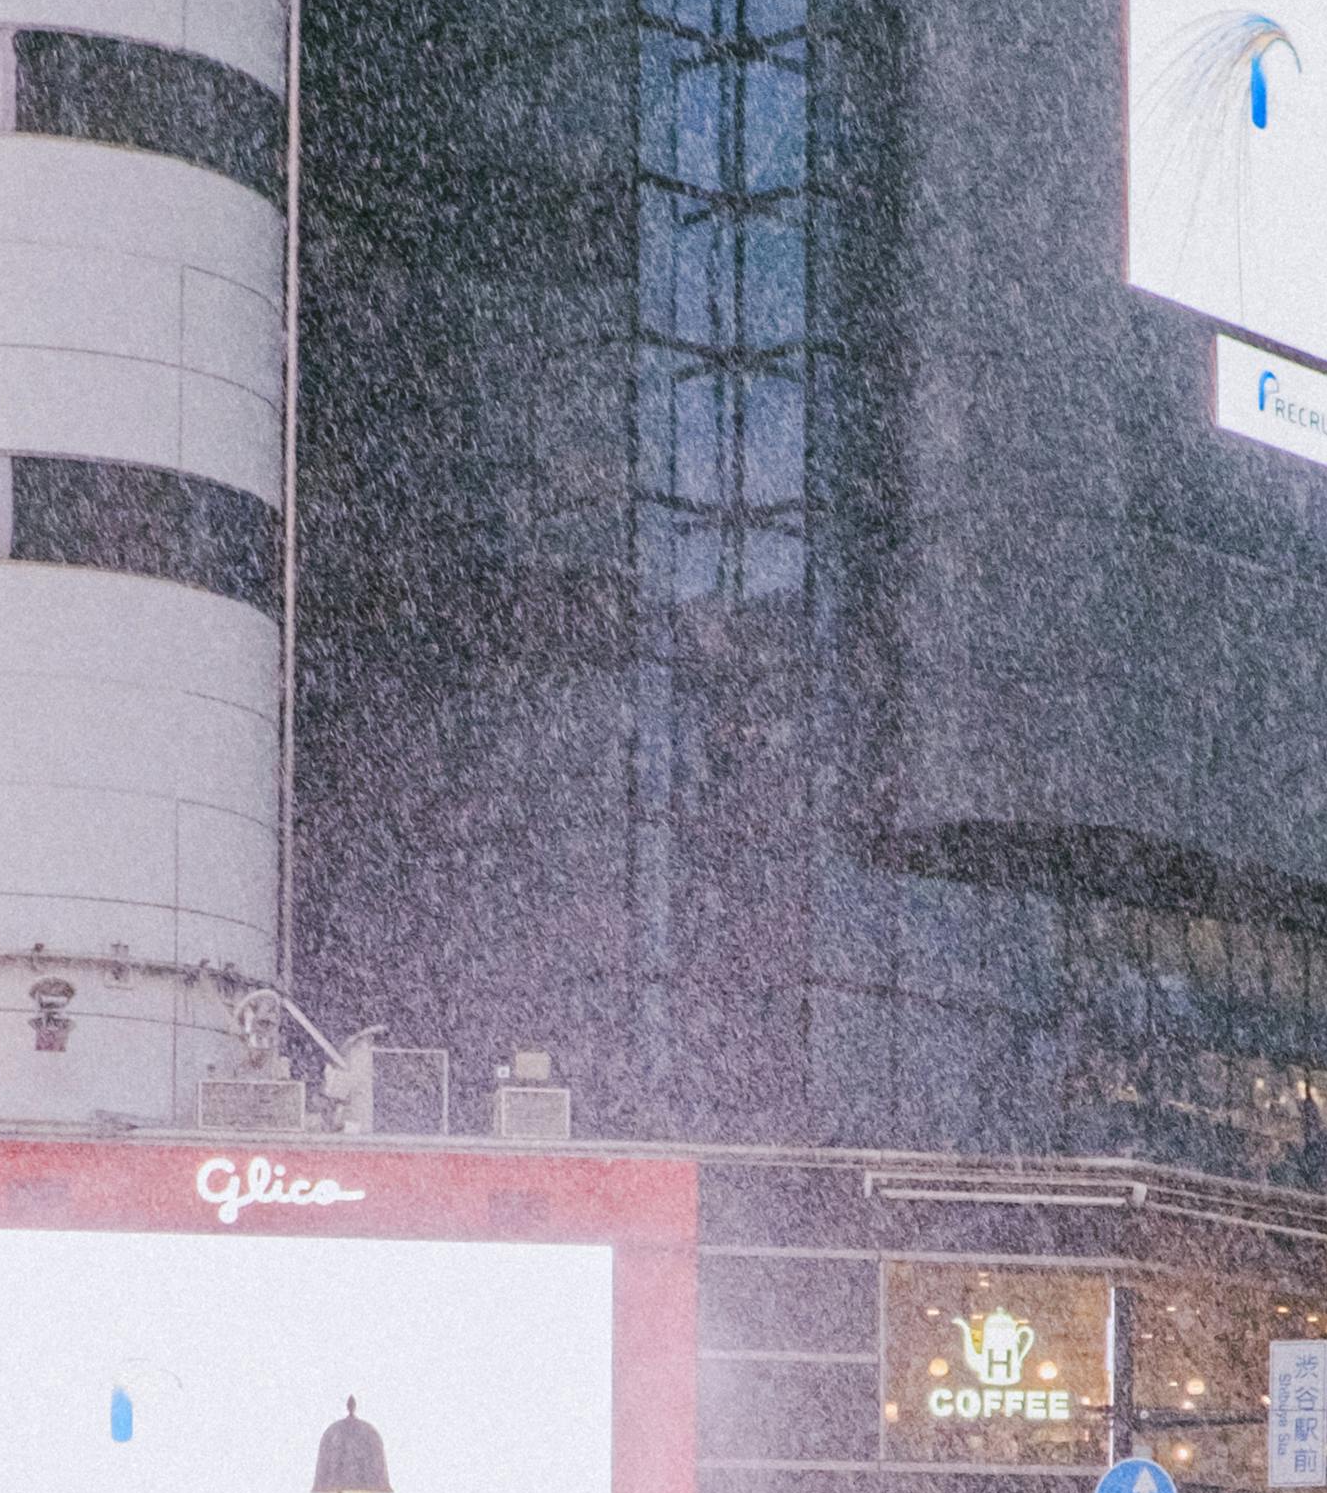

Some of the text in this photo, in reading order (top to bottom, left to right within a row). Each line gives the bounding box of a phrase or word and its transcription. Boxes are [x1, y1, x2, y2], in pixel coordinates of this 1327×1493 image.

[196, 1156, 365, 1224] Glico
[928, 1388, 1070, 1420] COFFEE
[1277, 1373, 1291, 1427] Shibuya
[1295, 1354, 1318, 1473] 渋谷駅前
